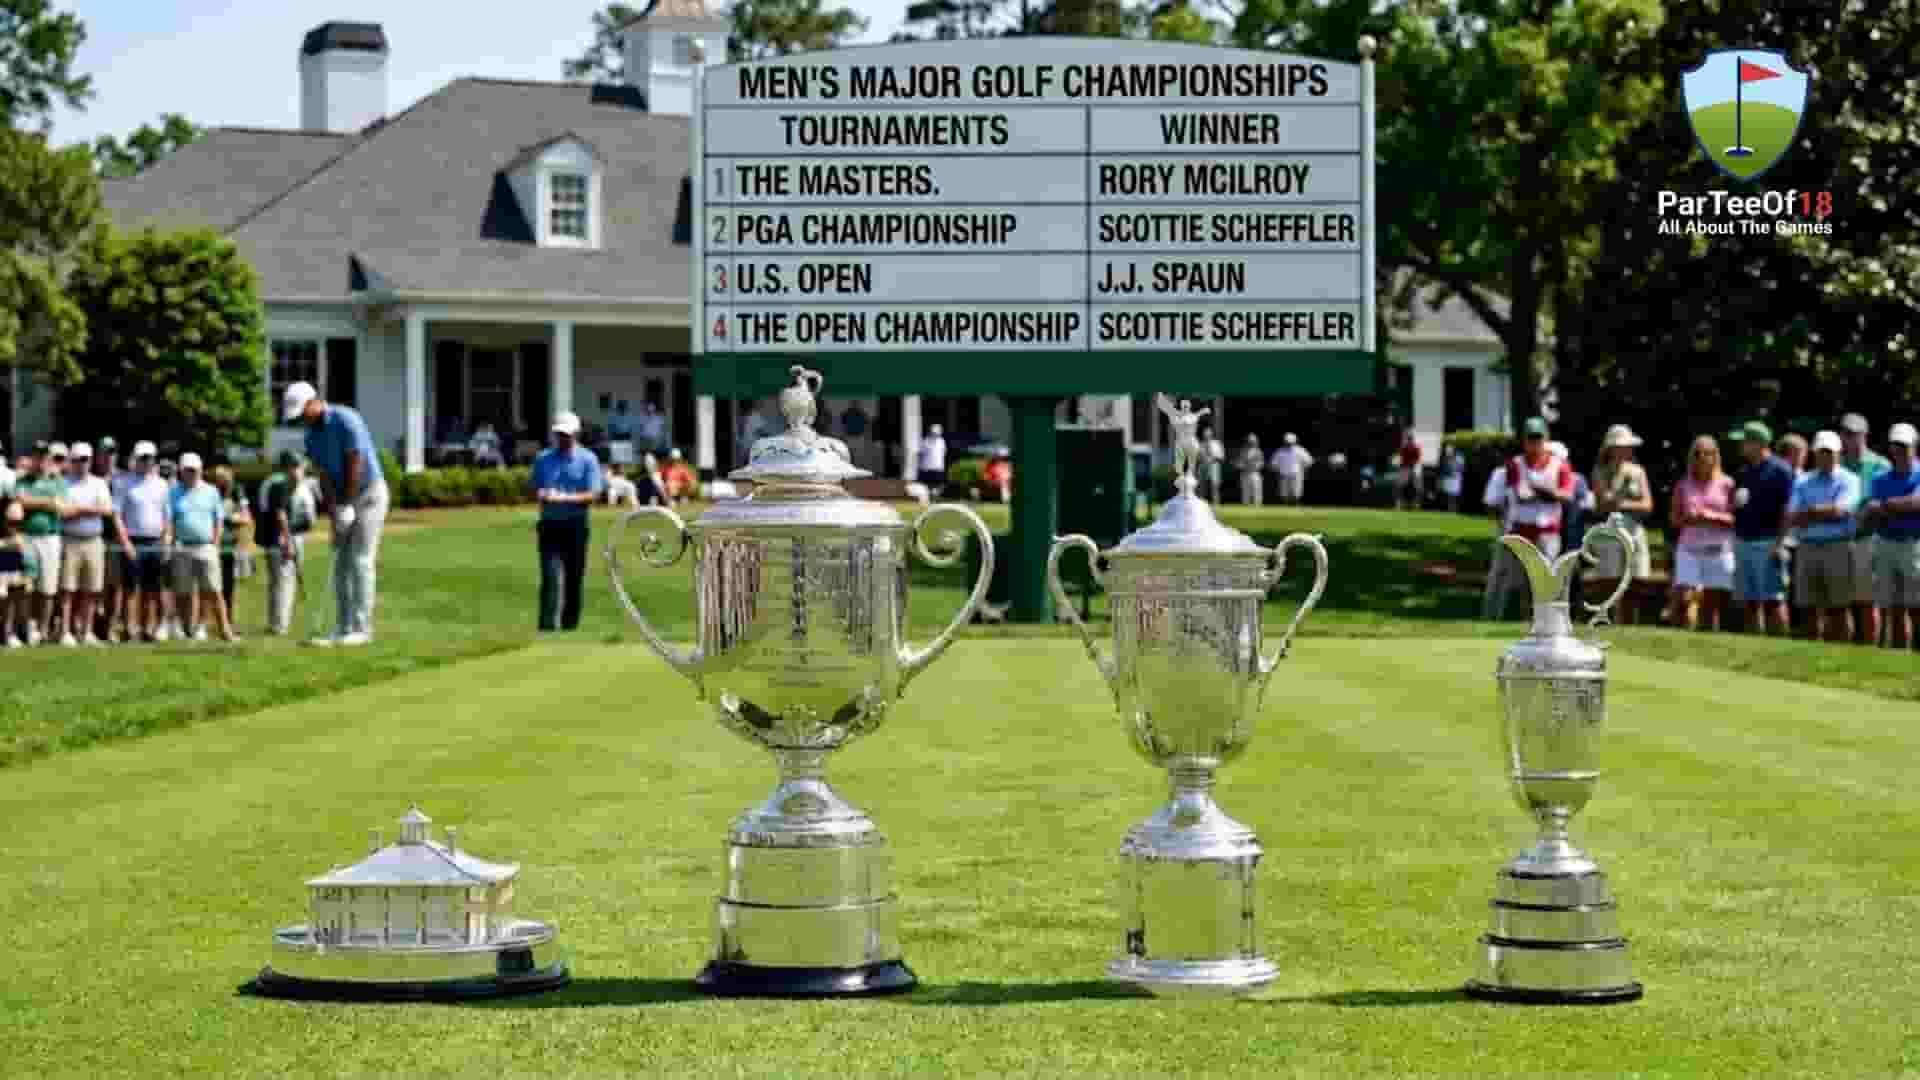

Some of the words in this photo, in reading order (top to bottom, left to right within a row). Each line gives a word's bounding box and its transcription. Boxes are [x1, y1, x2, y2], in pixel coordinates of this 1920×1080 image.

[740, 66, 840, 99] MEN'S
[850, 66, 960, 99] MAJOR
[973, 65, 1053, 98] GOLF
[1064, 64, 1328, 97] CHAMPIONSHIPS
[780, 115, 1008, 146] TOURNAMENTS
[1160, 113, 1279, 144] WINNER
[714, 168, 724, 196] 1
[736, 165, 790, 196] THE
[800, 165, 939, 195] MASTERS.
[1099, 164, 1176, 195] RORY
[1184, 164, 1310, 195] MCILROY
[712, 217, 727, 244] 2
[738, 215, 794, 245] PGA
[802, 214, 1016, 244] CHAMPIONSHIP
[1099, 214, 1205, 243] SCOTTIE
[1212, 214, 1354, 242] SCHEFFLER
[712, 264, 728, 294] 3
[738, 264, 788, 294] U.S.
[798, 264, 871, 293] OPEN
[1098, 263, 1143, 293] J.J.
[1152, 263, 1244, 294] SPAUN
[713, 316, 727, 343] 4
[736, 312, 787, 344] THE
[796, 312, 866, 343] OPEN
[875, 312, 1080, 343] CHAMPIONSHIP
[1099, 312, 1204, 341] SCOTTIE
[1212, 312, 1354, 341] SCHEFFLER
